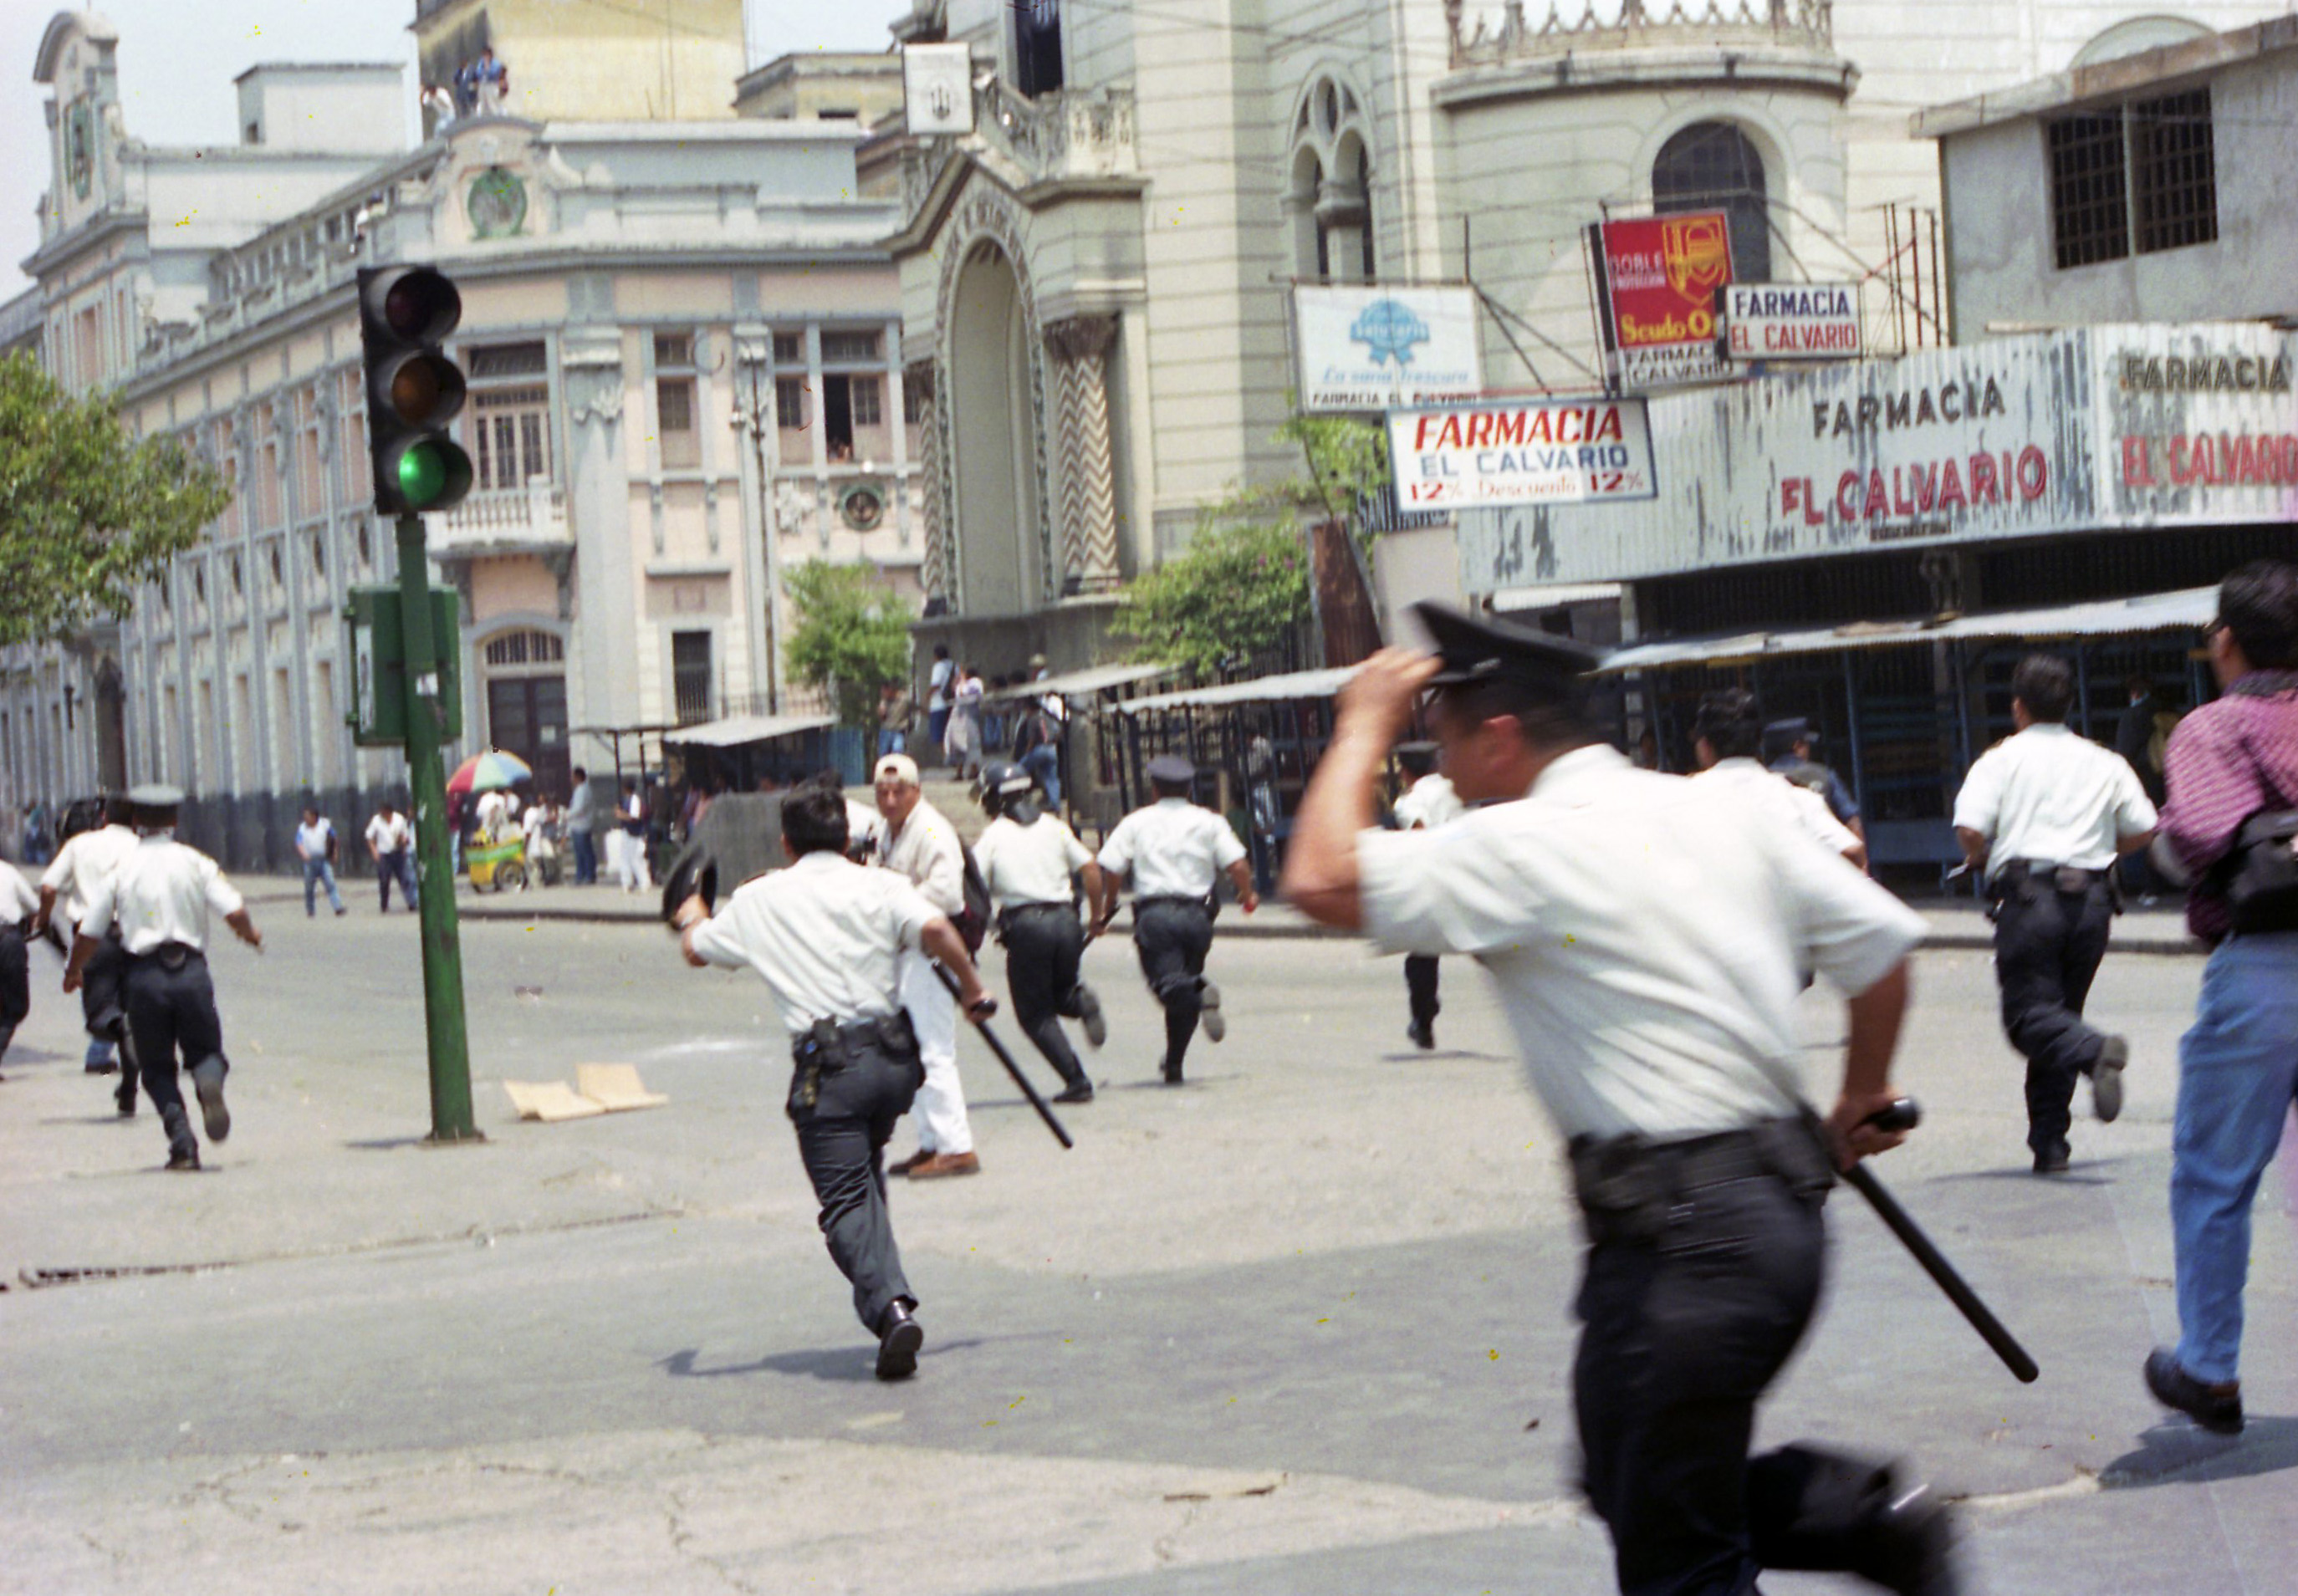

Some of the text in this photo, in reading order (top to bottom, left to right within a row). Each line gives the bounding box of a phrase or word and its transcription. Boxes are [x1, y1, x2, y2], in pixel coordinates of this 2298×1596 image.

[1730, 322, 1856, 352] EL CALVARIO
[2122, 353, 2290, 392] FARMACIA
[1813, 375, 2005, 438] FARMACIA
[1414, 405, 1623, 451] FARMACIA
[1421, 444, 1630, 477] EL CALVARIO
[2122, 431, 2298, 487] EL CALVARIO
[1590, 470, 1644, 494] 12%
[1836, 443, 2047, 523] CALVARIO
